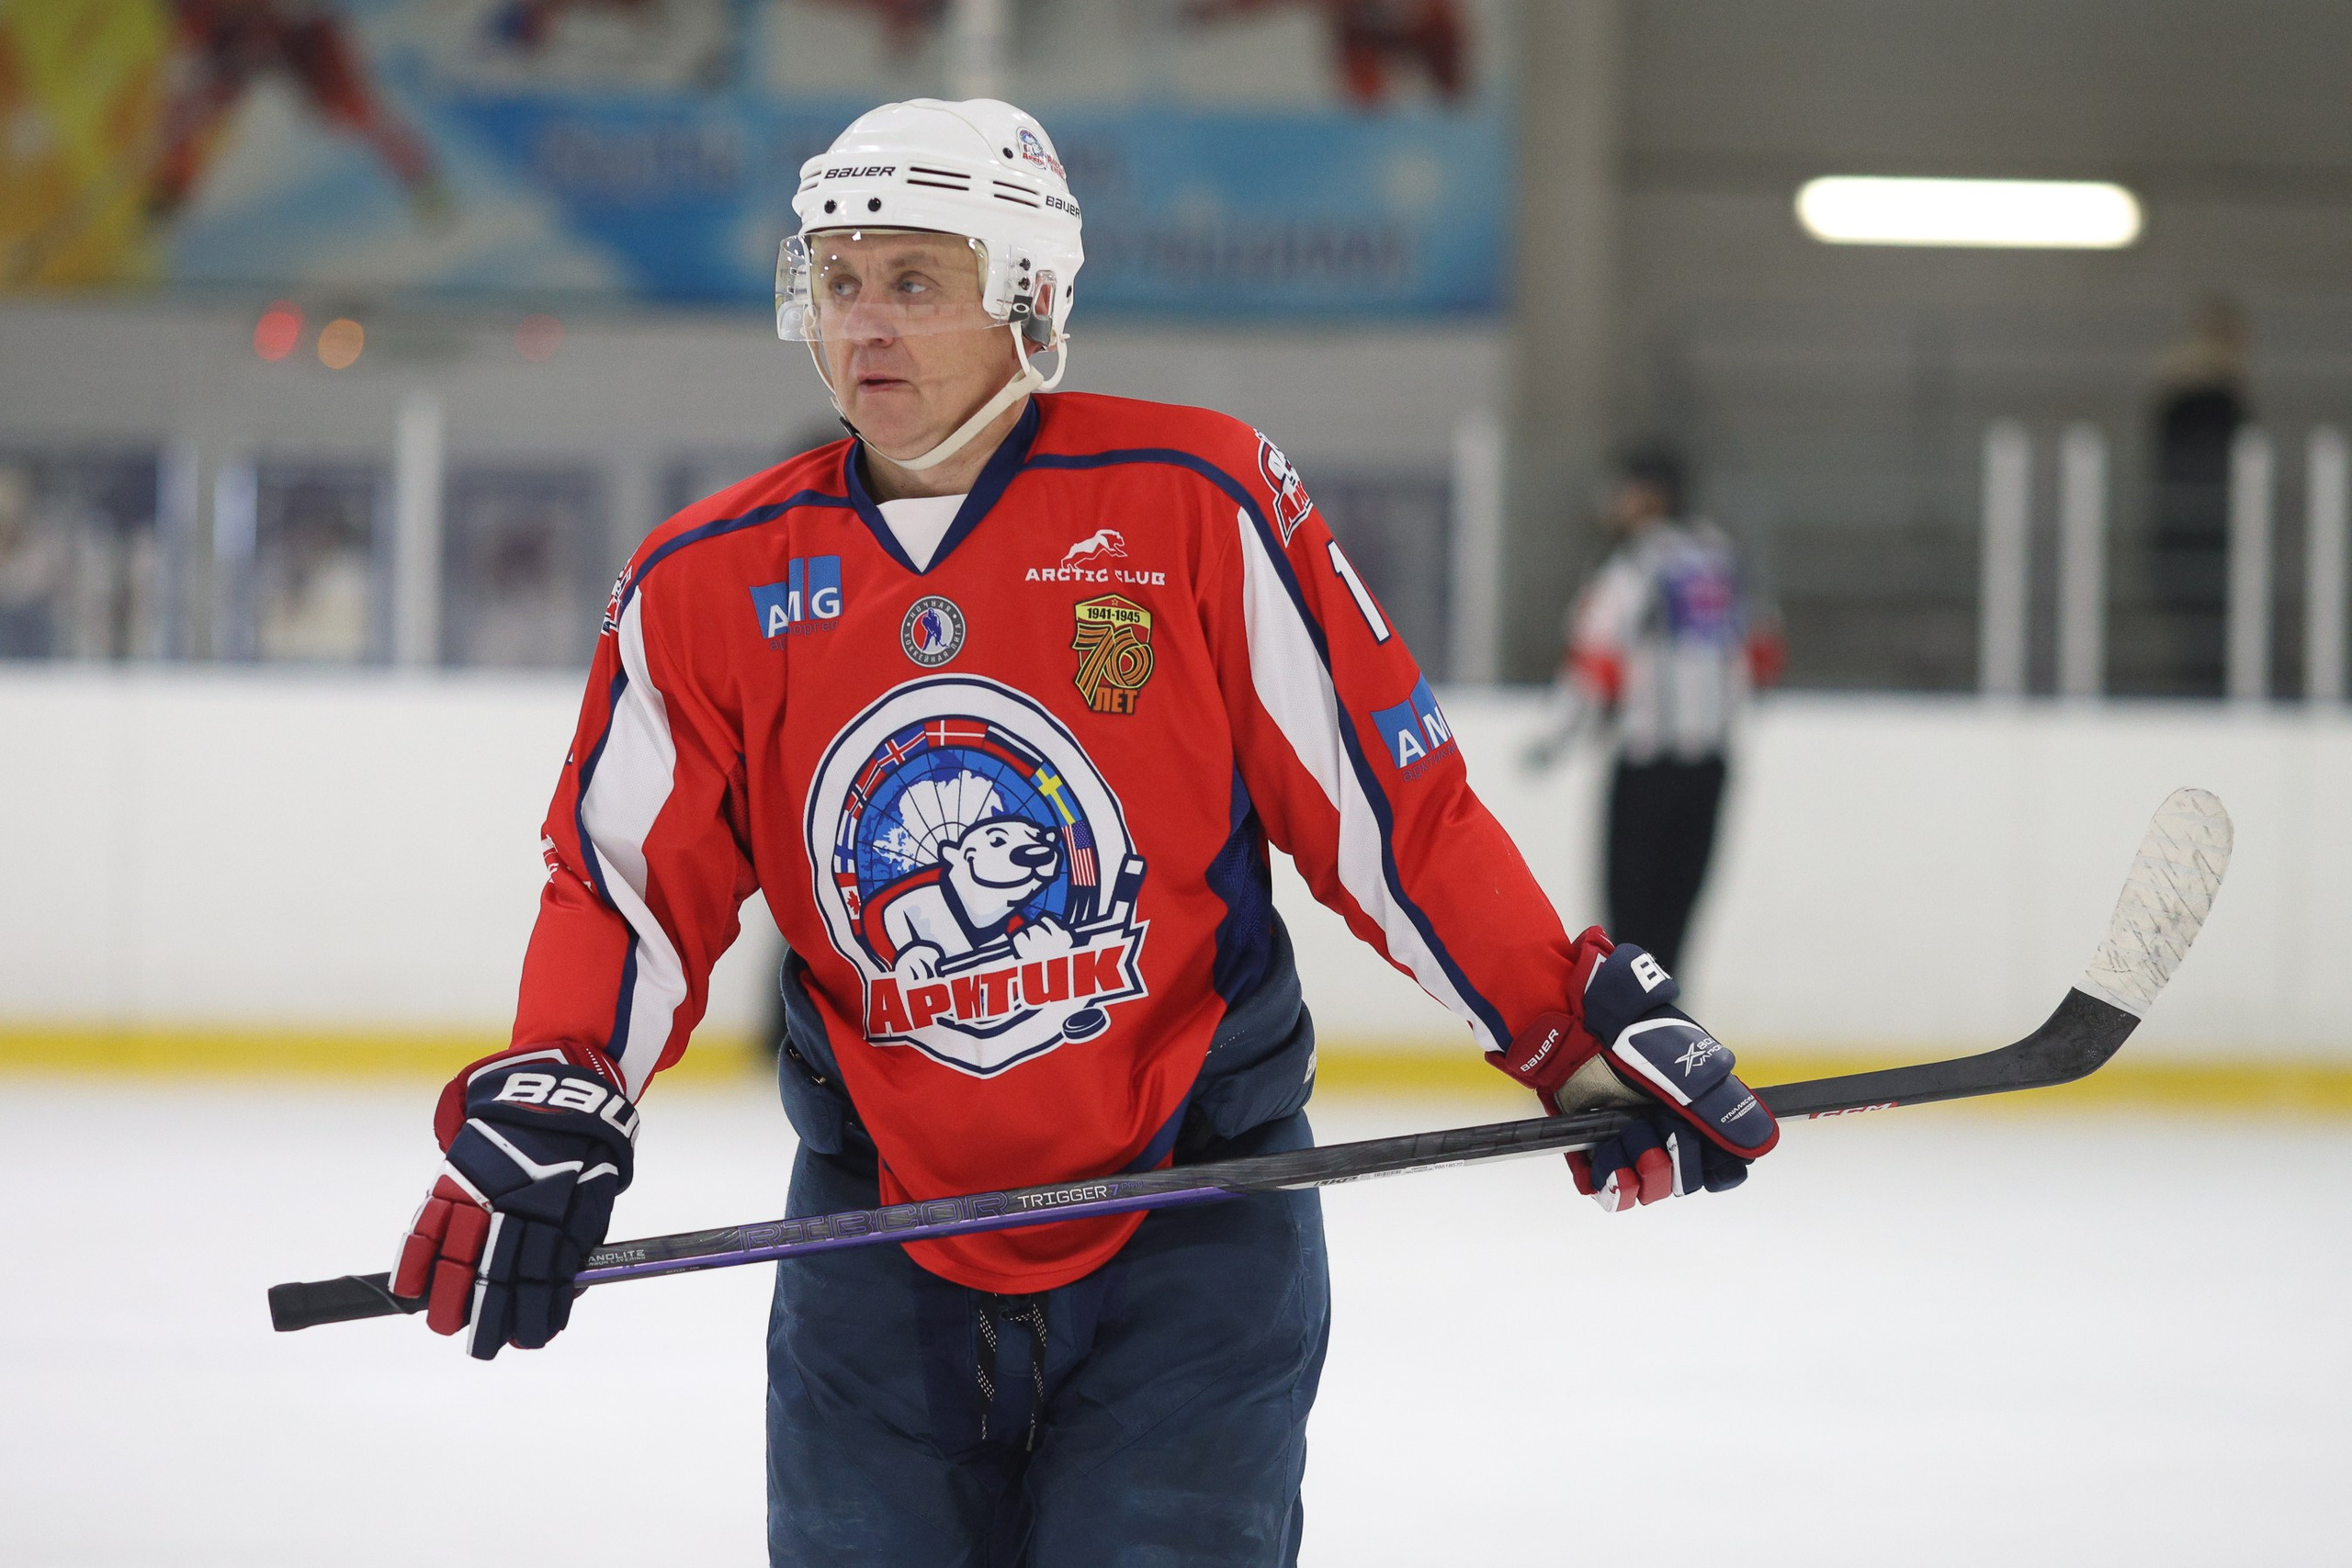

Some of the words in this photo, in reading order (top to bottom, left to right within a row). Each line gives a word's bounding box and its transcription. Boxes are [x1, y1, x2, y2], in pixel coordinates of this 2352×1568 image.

[824, 166, 896, 179] BAUER
[1046, 195, 1080, 220] BAUER
[1025, 568, 1109, 582] ARCTIC
[1114, 570, 1166, 586] CLUB
[910, 600, 952, 619] НОЧНАЯ
[1087, 606, 1141, 624] 1941-1945
[904, 633, 949, 663] ХОККЕЙНАЯ
[950, 623, 962, 650] ЛИГА
[1093, 686, 1140, 715] ЛЕТ
[1397, 705, 1453, 769] AM
[1521, 1028, 1560, 1073] BAUER
[1692, 1043, 1724, 1067] VAPO
[492, 1072, 641, 1143] BAU
[737, 1190, 1010, 1253] RIBCOR
[1018, 1184, 1107, 1209] TRIGGER
[1108, 1182, 1120, 1197] 7
[588, 1249, 645, 1262] ANOLITE
